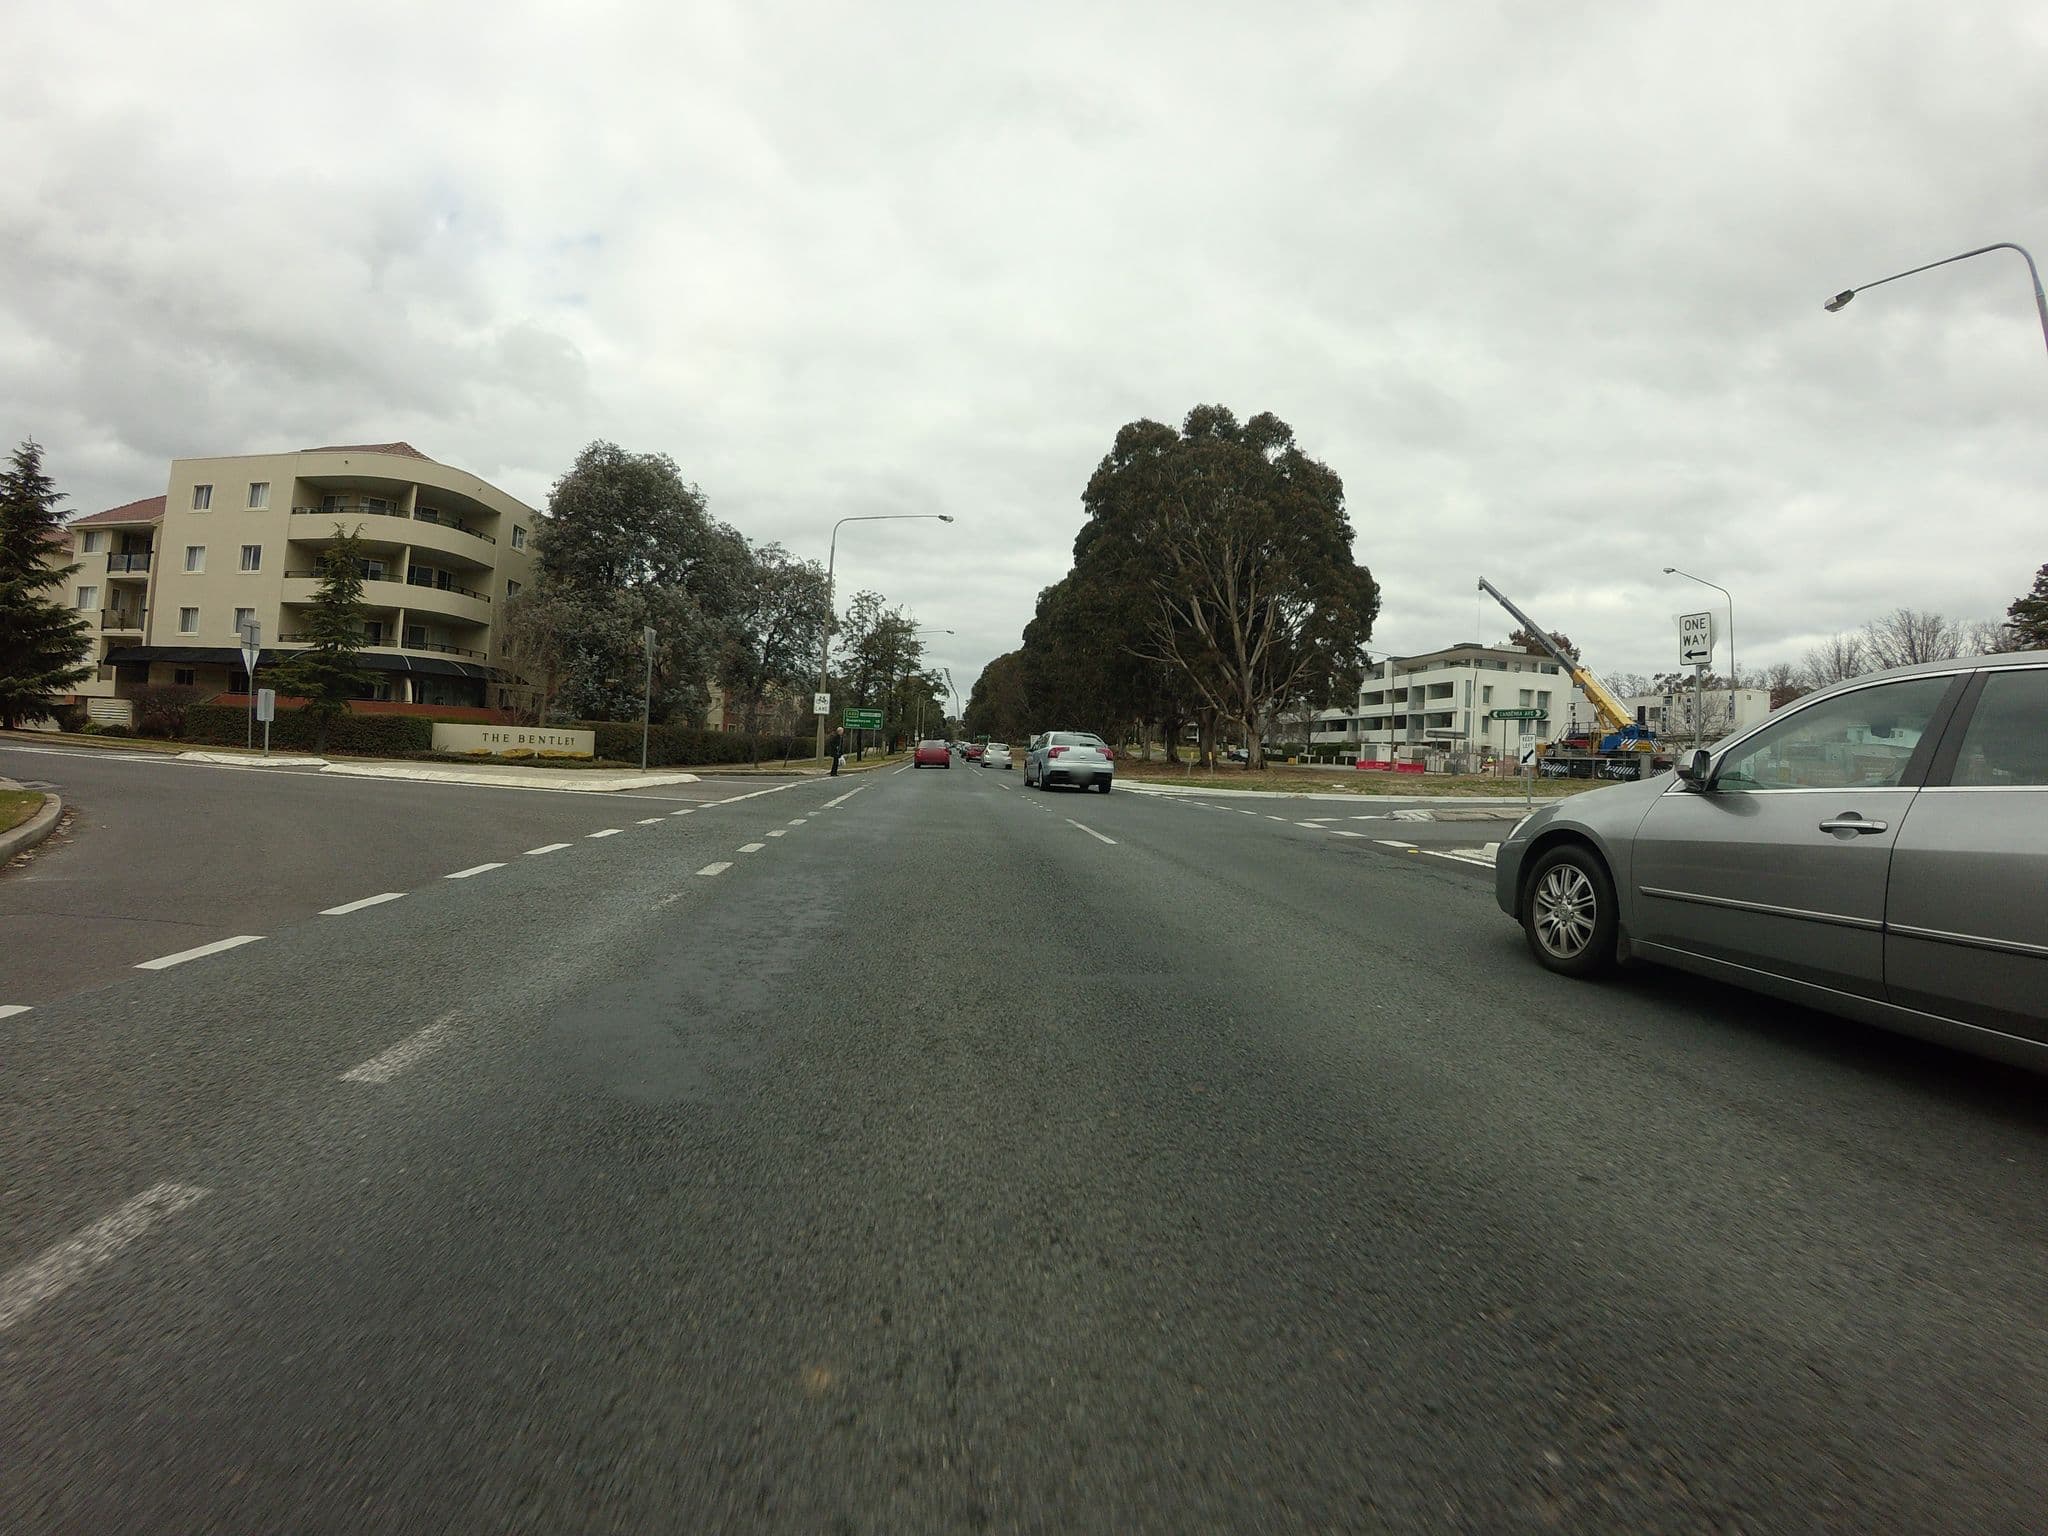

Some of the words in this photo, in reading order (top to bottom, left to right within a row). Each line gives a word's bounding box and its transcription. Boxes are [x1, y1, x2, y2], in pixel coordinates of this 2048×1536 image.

[1684, 617, 1706, 631] ONE
[1683, 633, 1707, 646] WAY
[482, 732, 510, 743] THE
[518, 734, 576, 746] BENTLEY
